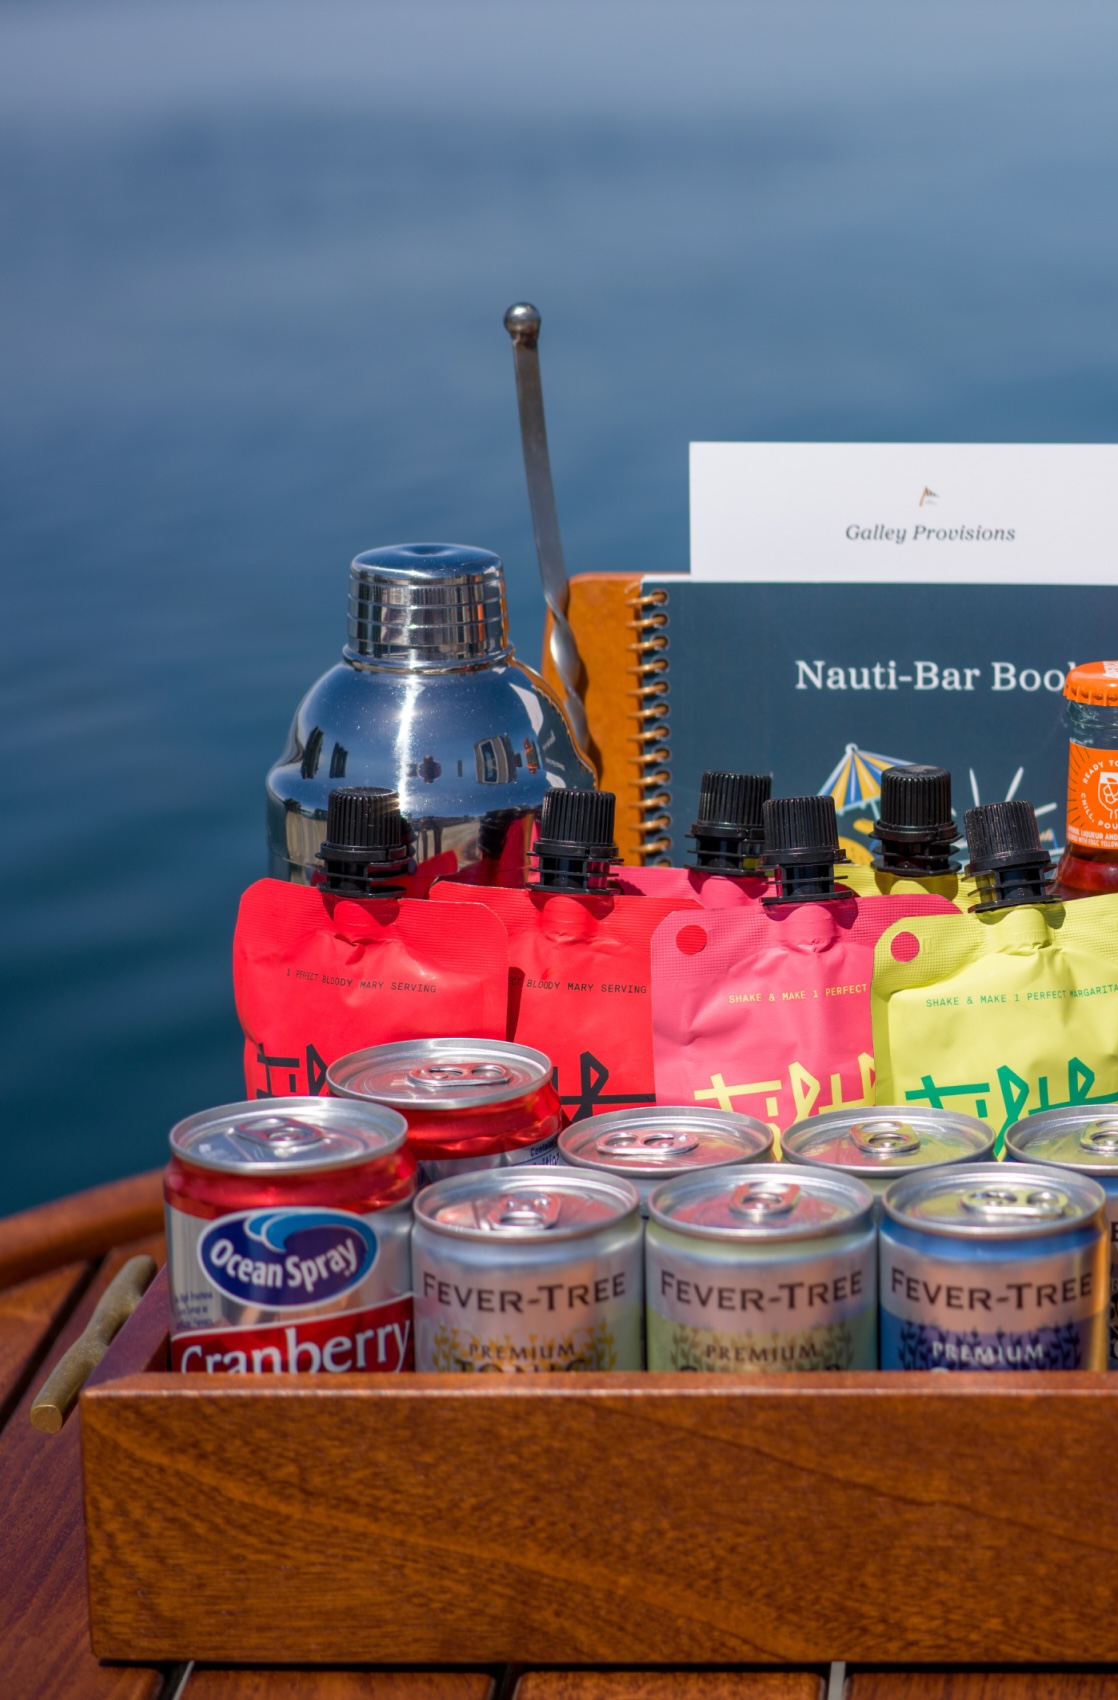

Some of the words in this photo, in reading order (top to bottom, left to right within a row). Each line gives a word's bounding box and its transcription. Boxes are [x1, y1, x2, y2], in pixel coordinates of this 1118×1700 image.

[845, 524, 907, 545] Galley
[912, 524, 1016, 542] Provisions
[795, 660, 981, 691] Nauti-Bar
[991, 661, 1076, 692] Boo
[1082, 761, 1104, 784] READY
[286, 968, 291, 977] 1
[295, 969, 319, 982] PERFECT
[322, 975, 353, 988] BLOODY
[360, 980, 384, 990] MARY
[391, 981, 437, 993] SERVING
[526, 979, 561, 991] BLOODY
[567, 982, 594, 992] MARY
[601, 983, 647, 994] SERVING
[728, 993, 762, 1004] SHAKE
[768, 993, 776, 1002] &
[782, 990, 806, 1001] MAKE
[812, 989, 818, 998] 1
[825, 983, 868, 997] PERFECT
[926, 996, 960, 1008] SHAKE
[966, 996, 974, 1005] &
[980, 994, 1007, 1004] MAKE
[1014, 993, 1020, 1002] 1
[1027, 989, 1067, 1001] PERFECT
[210, 1238, 283, 1289] Ocean
[284, 1238, 358, 1293] Spray
[423, 1271, 626, 1313] FEVER-TREE
[661, 1269, 863, 1312] FEVER-TREE
[891, 1267, 1093, 1311] FEVER-TREE
[469, 1343, 576, 1361] PREMIUM
[706, 1343, 818, 1363] PREMIUM
[931, 1341, 1044, 1364] PREMIUM
